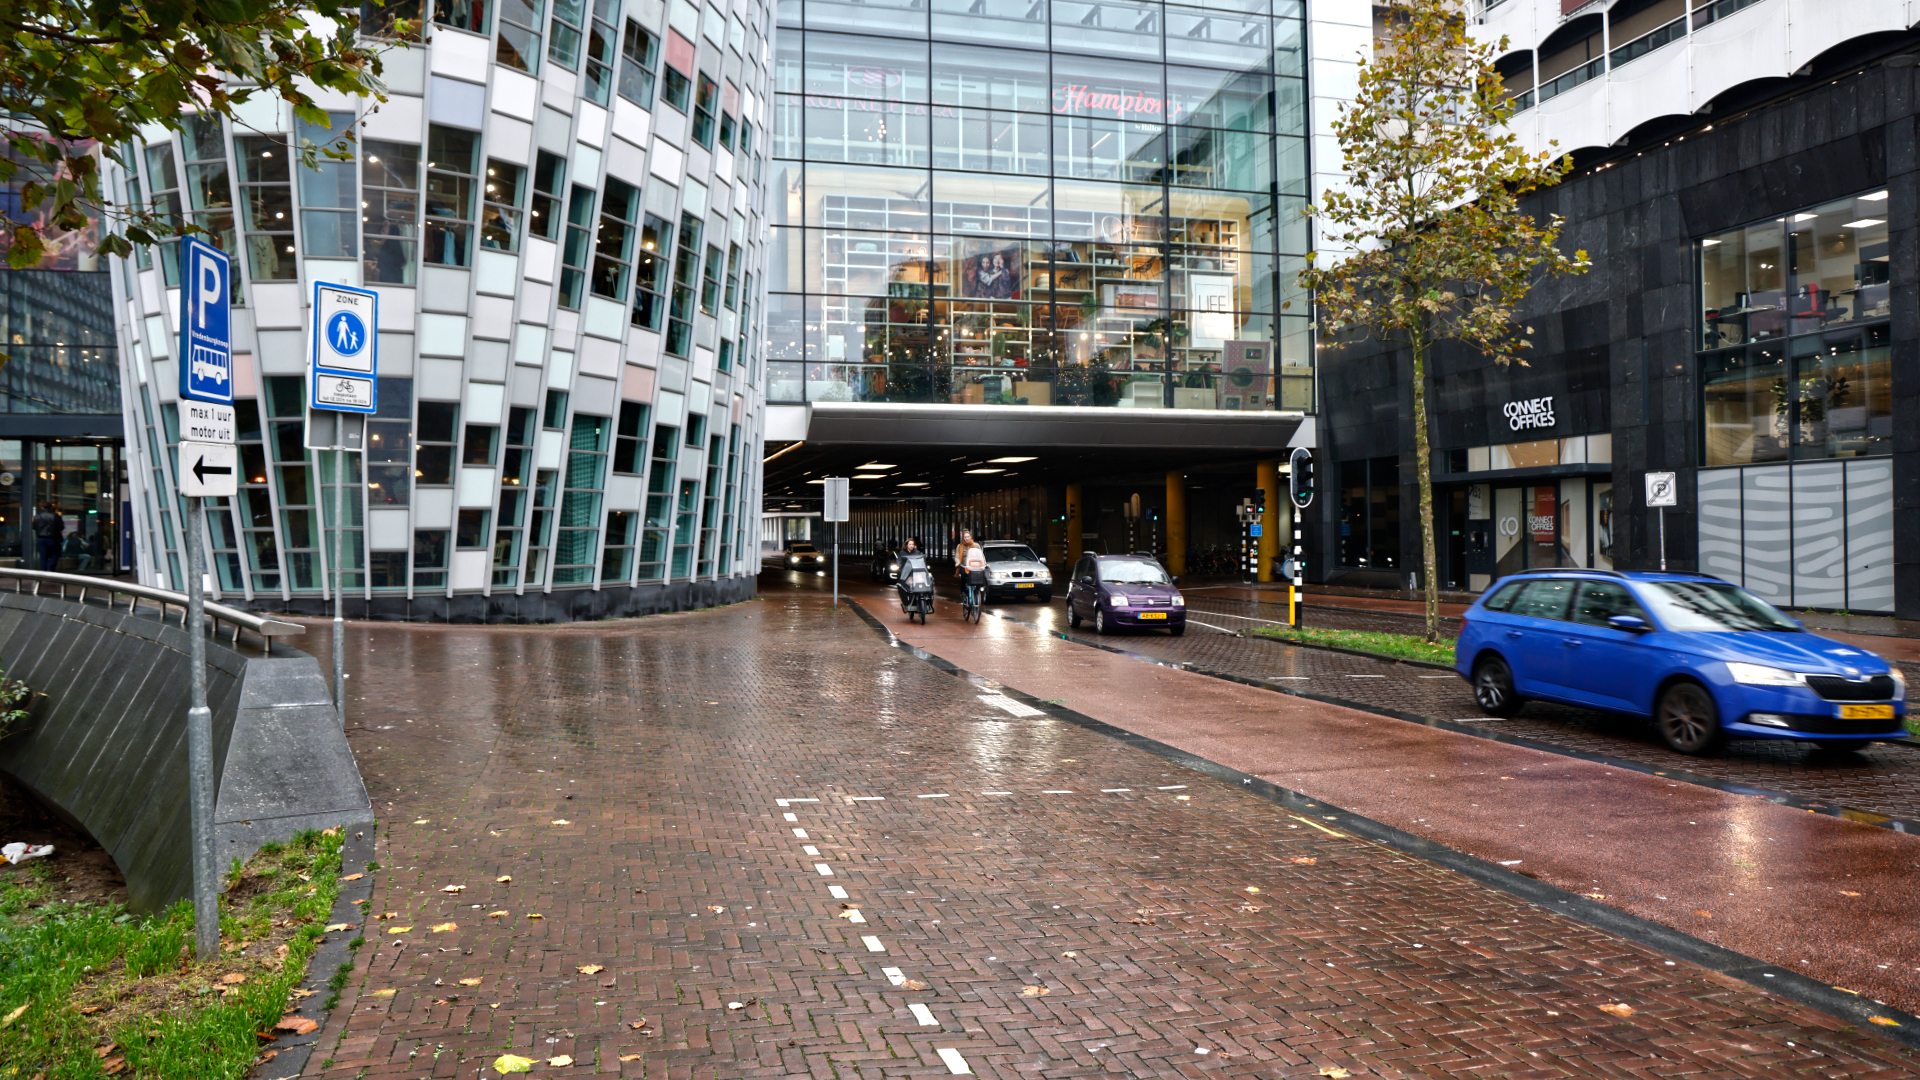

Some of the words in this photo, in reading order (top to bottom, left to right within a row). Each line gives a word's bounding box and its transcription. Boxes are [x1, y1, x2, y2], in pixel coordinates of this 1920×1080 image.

[1052, 85, 1180, 117] Hampton
[199, 253, 221, 329] P
[336, 294, 359, 306] ZONE
[191, 407, 209, 420] max
[217, 411, 231, 422] uur
[1503, 396, 1553, 418] CONNECT
[1509, 411, 1556, 431] OFFICES
[191, 426, 216, 439] motor
[219, 428, 230, 440] uit
[1528, 515, 1554, 525] CONNECT
[1531, 522, 1554, 531] OFFICES
